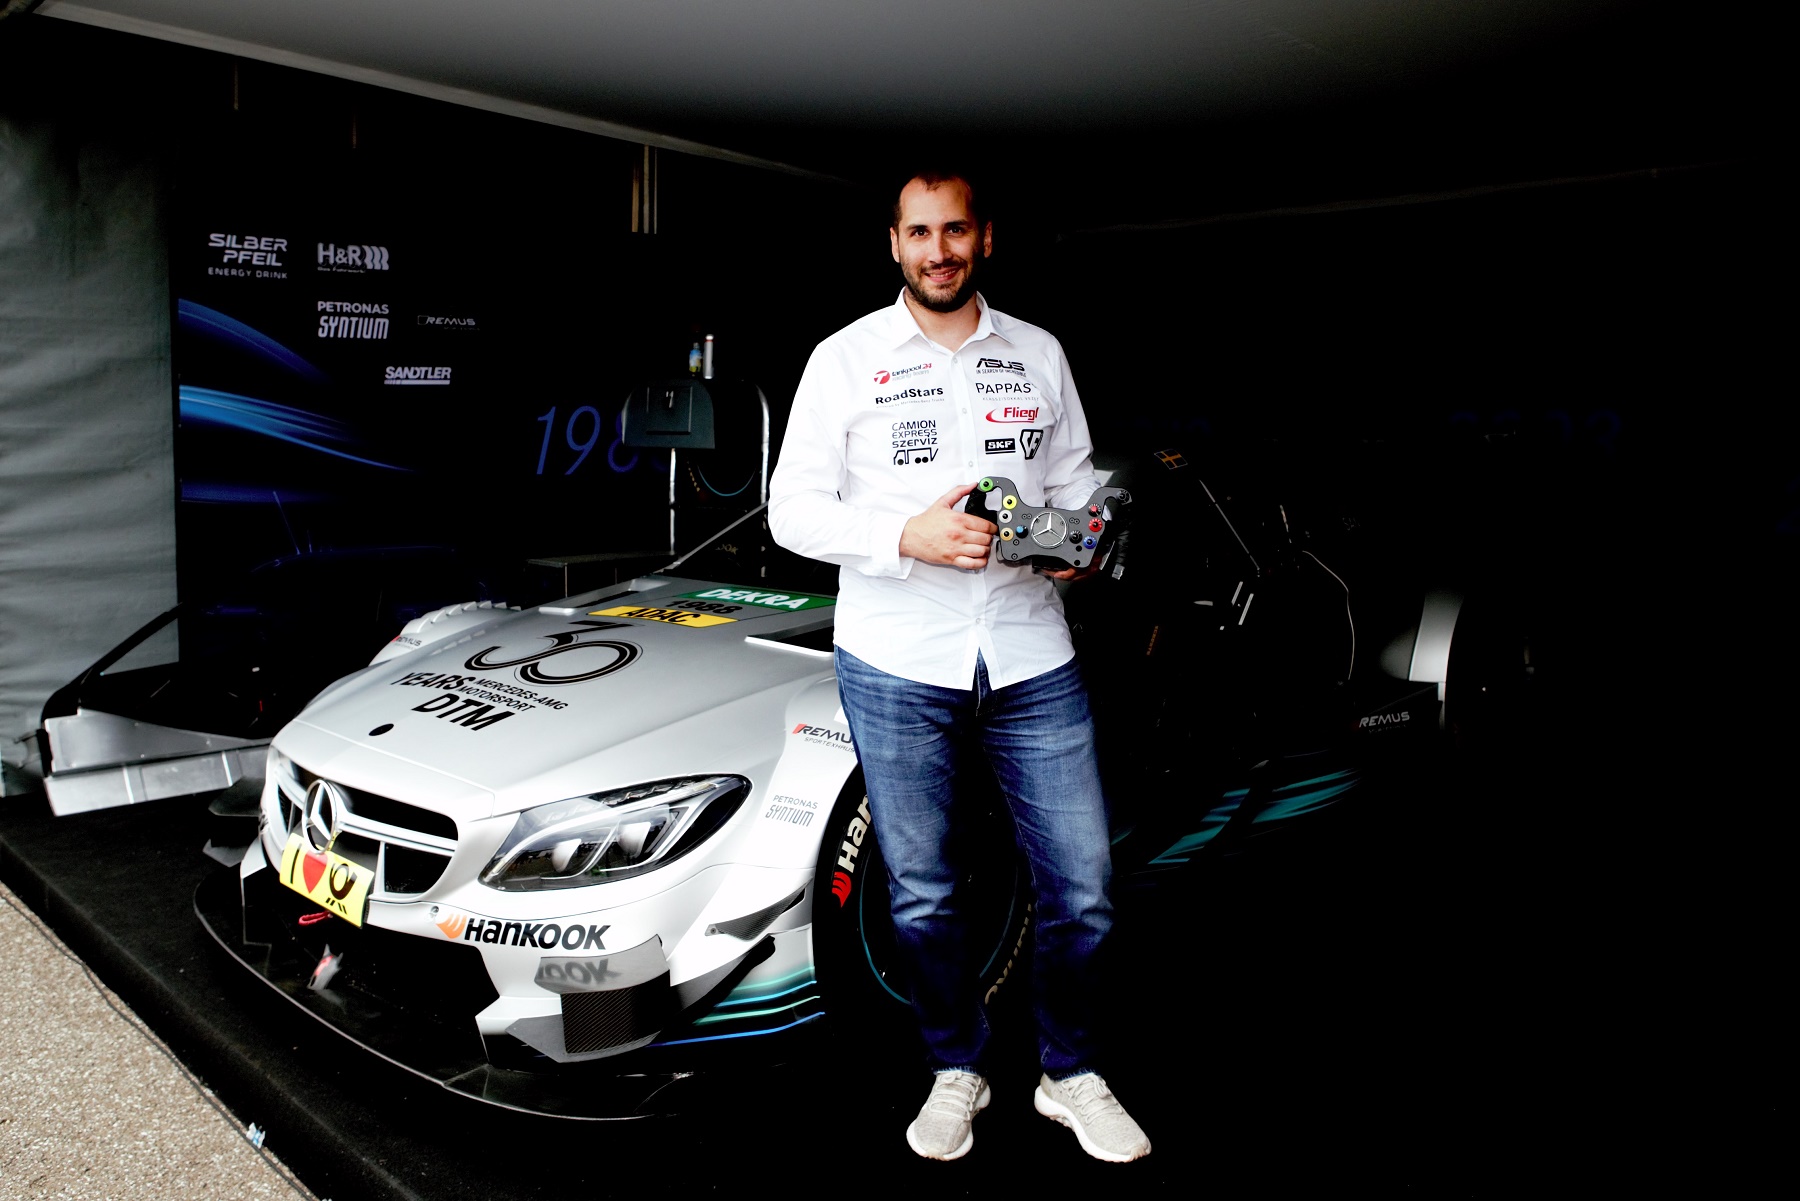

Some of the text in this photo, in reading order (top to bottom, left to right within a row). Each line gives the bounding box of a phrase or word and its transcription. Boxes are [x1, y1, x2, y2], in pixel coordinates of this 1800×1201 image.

[208, 233, 288, 252] SILBER
[222, 250, 282, 266] PFEIL
[317, 242, 362, 266] H&R
[208, 267, 288, 280] ENERGY DRINK
[317, 301, 389, 315] PETRONAS
[318, 315, 389, 340] SYNTIUM
[425, 316, 476, 326] REMUS
[976, 357, 1025, 371] ASUS
[385, 366, 452, 380] SANDTLER
[875, 387, 944, 404] RoadStars
[975, 382, 1032, 394] PAPPAS
[1003, 406, 1040, 421] Fliegl
[892, 419, 936, 431] CAMION
[892, 428, 938, 439] EXPRESS
[987, 440, 1014, 450] SKF
[665, 599, 744, 615] 1988
[696, 588, 810, 610] DEKRA
[616, 607, 701, 623] ADAC
[463, 620, 643, 687] 30
[390, 672, 476, 691] YEARS
[455, 685, 537, 712] MOTORSPORT
[474, 678, 569, 711] MERCEDES-AMG
[411, 692, 516, 731] DTM
[1358, 710, 1411, 728] REMUS
[773, 794, 819, 810] PETRONAS
[765, 804, 815, 827] SYNTIUM
